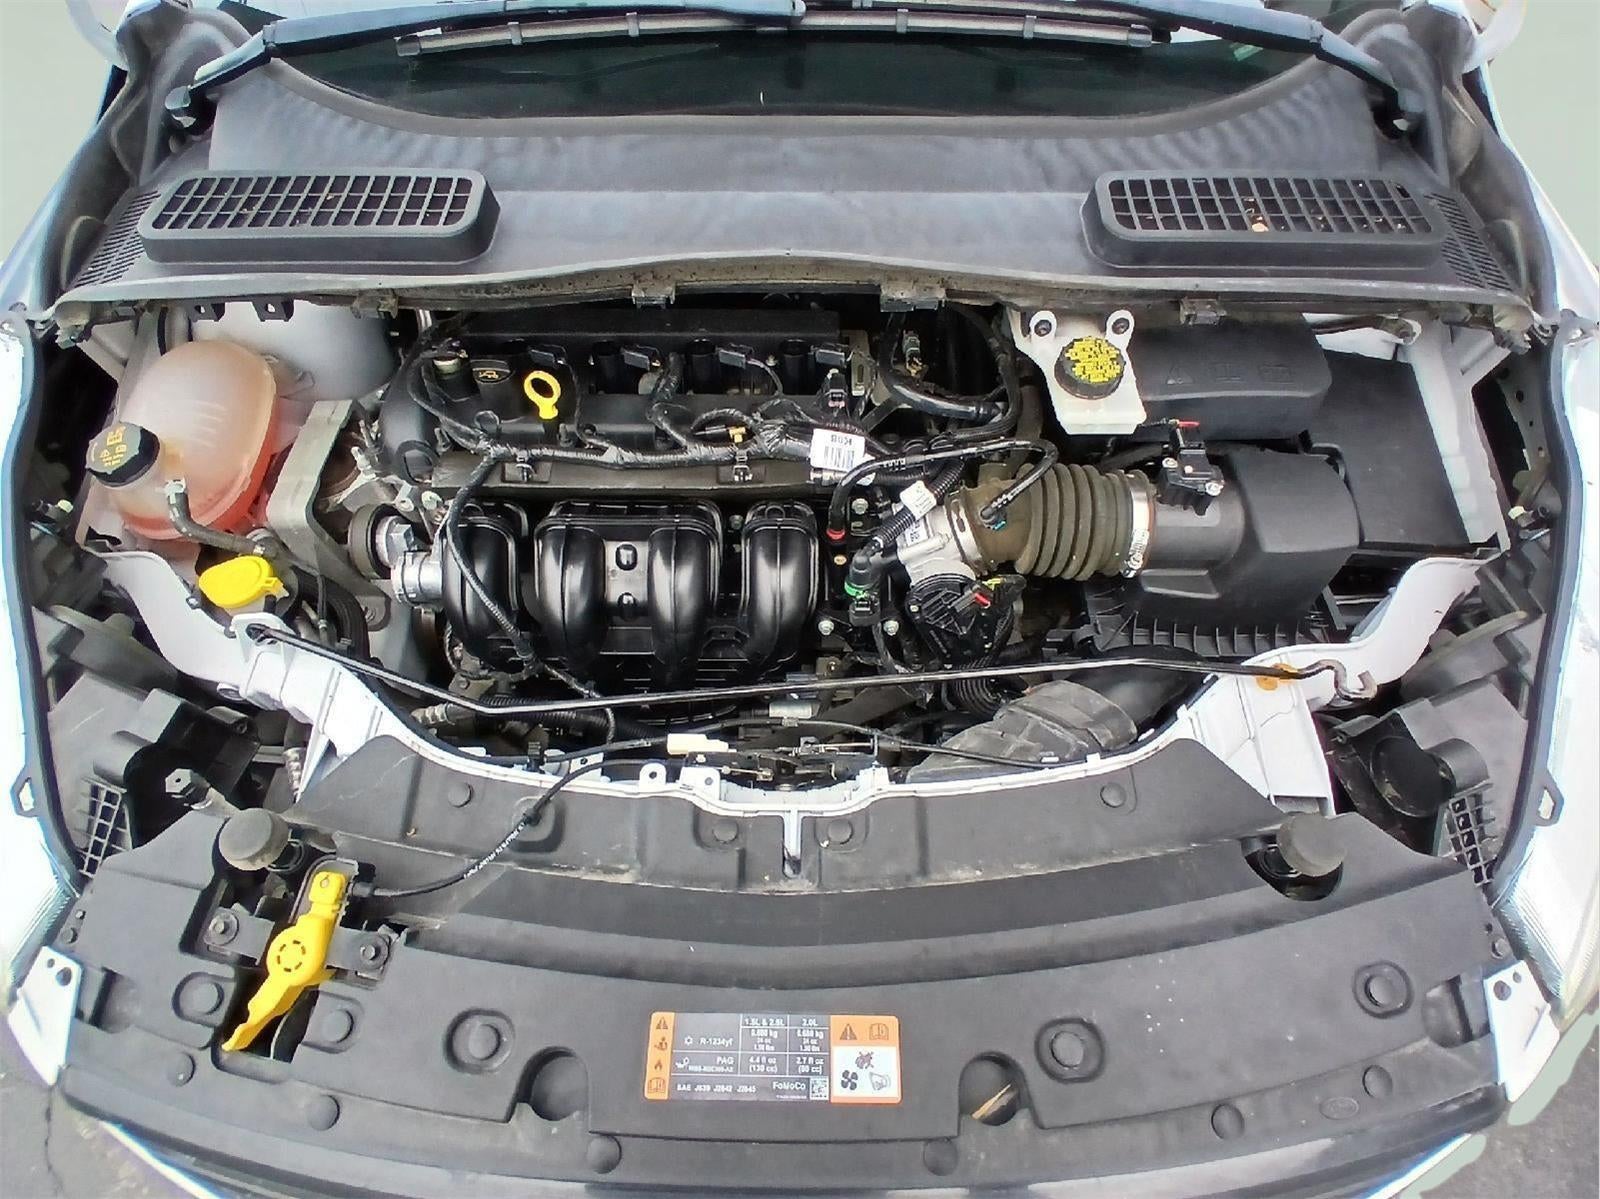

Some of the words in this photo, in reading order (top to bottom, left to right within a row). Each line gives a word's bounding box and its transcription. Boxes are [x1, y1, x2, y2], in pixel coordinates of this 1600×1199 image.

[801, 1018, 818, 1026] 2.0L
[769, 1029, 778, 1039] kg
[815, 1030, 824, 1039] kg
[700, 1037, 733, 1047] R-1234yf
[716, 1057, 734, 1065] PAG
[749, 1056, 759, 1064] 4.4
[796, 1057, 807, 1065] 2.7
[677, 1084, 691, 1092] SAE
[772, 1081, 806, 1091] FoMoCo
